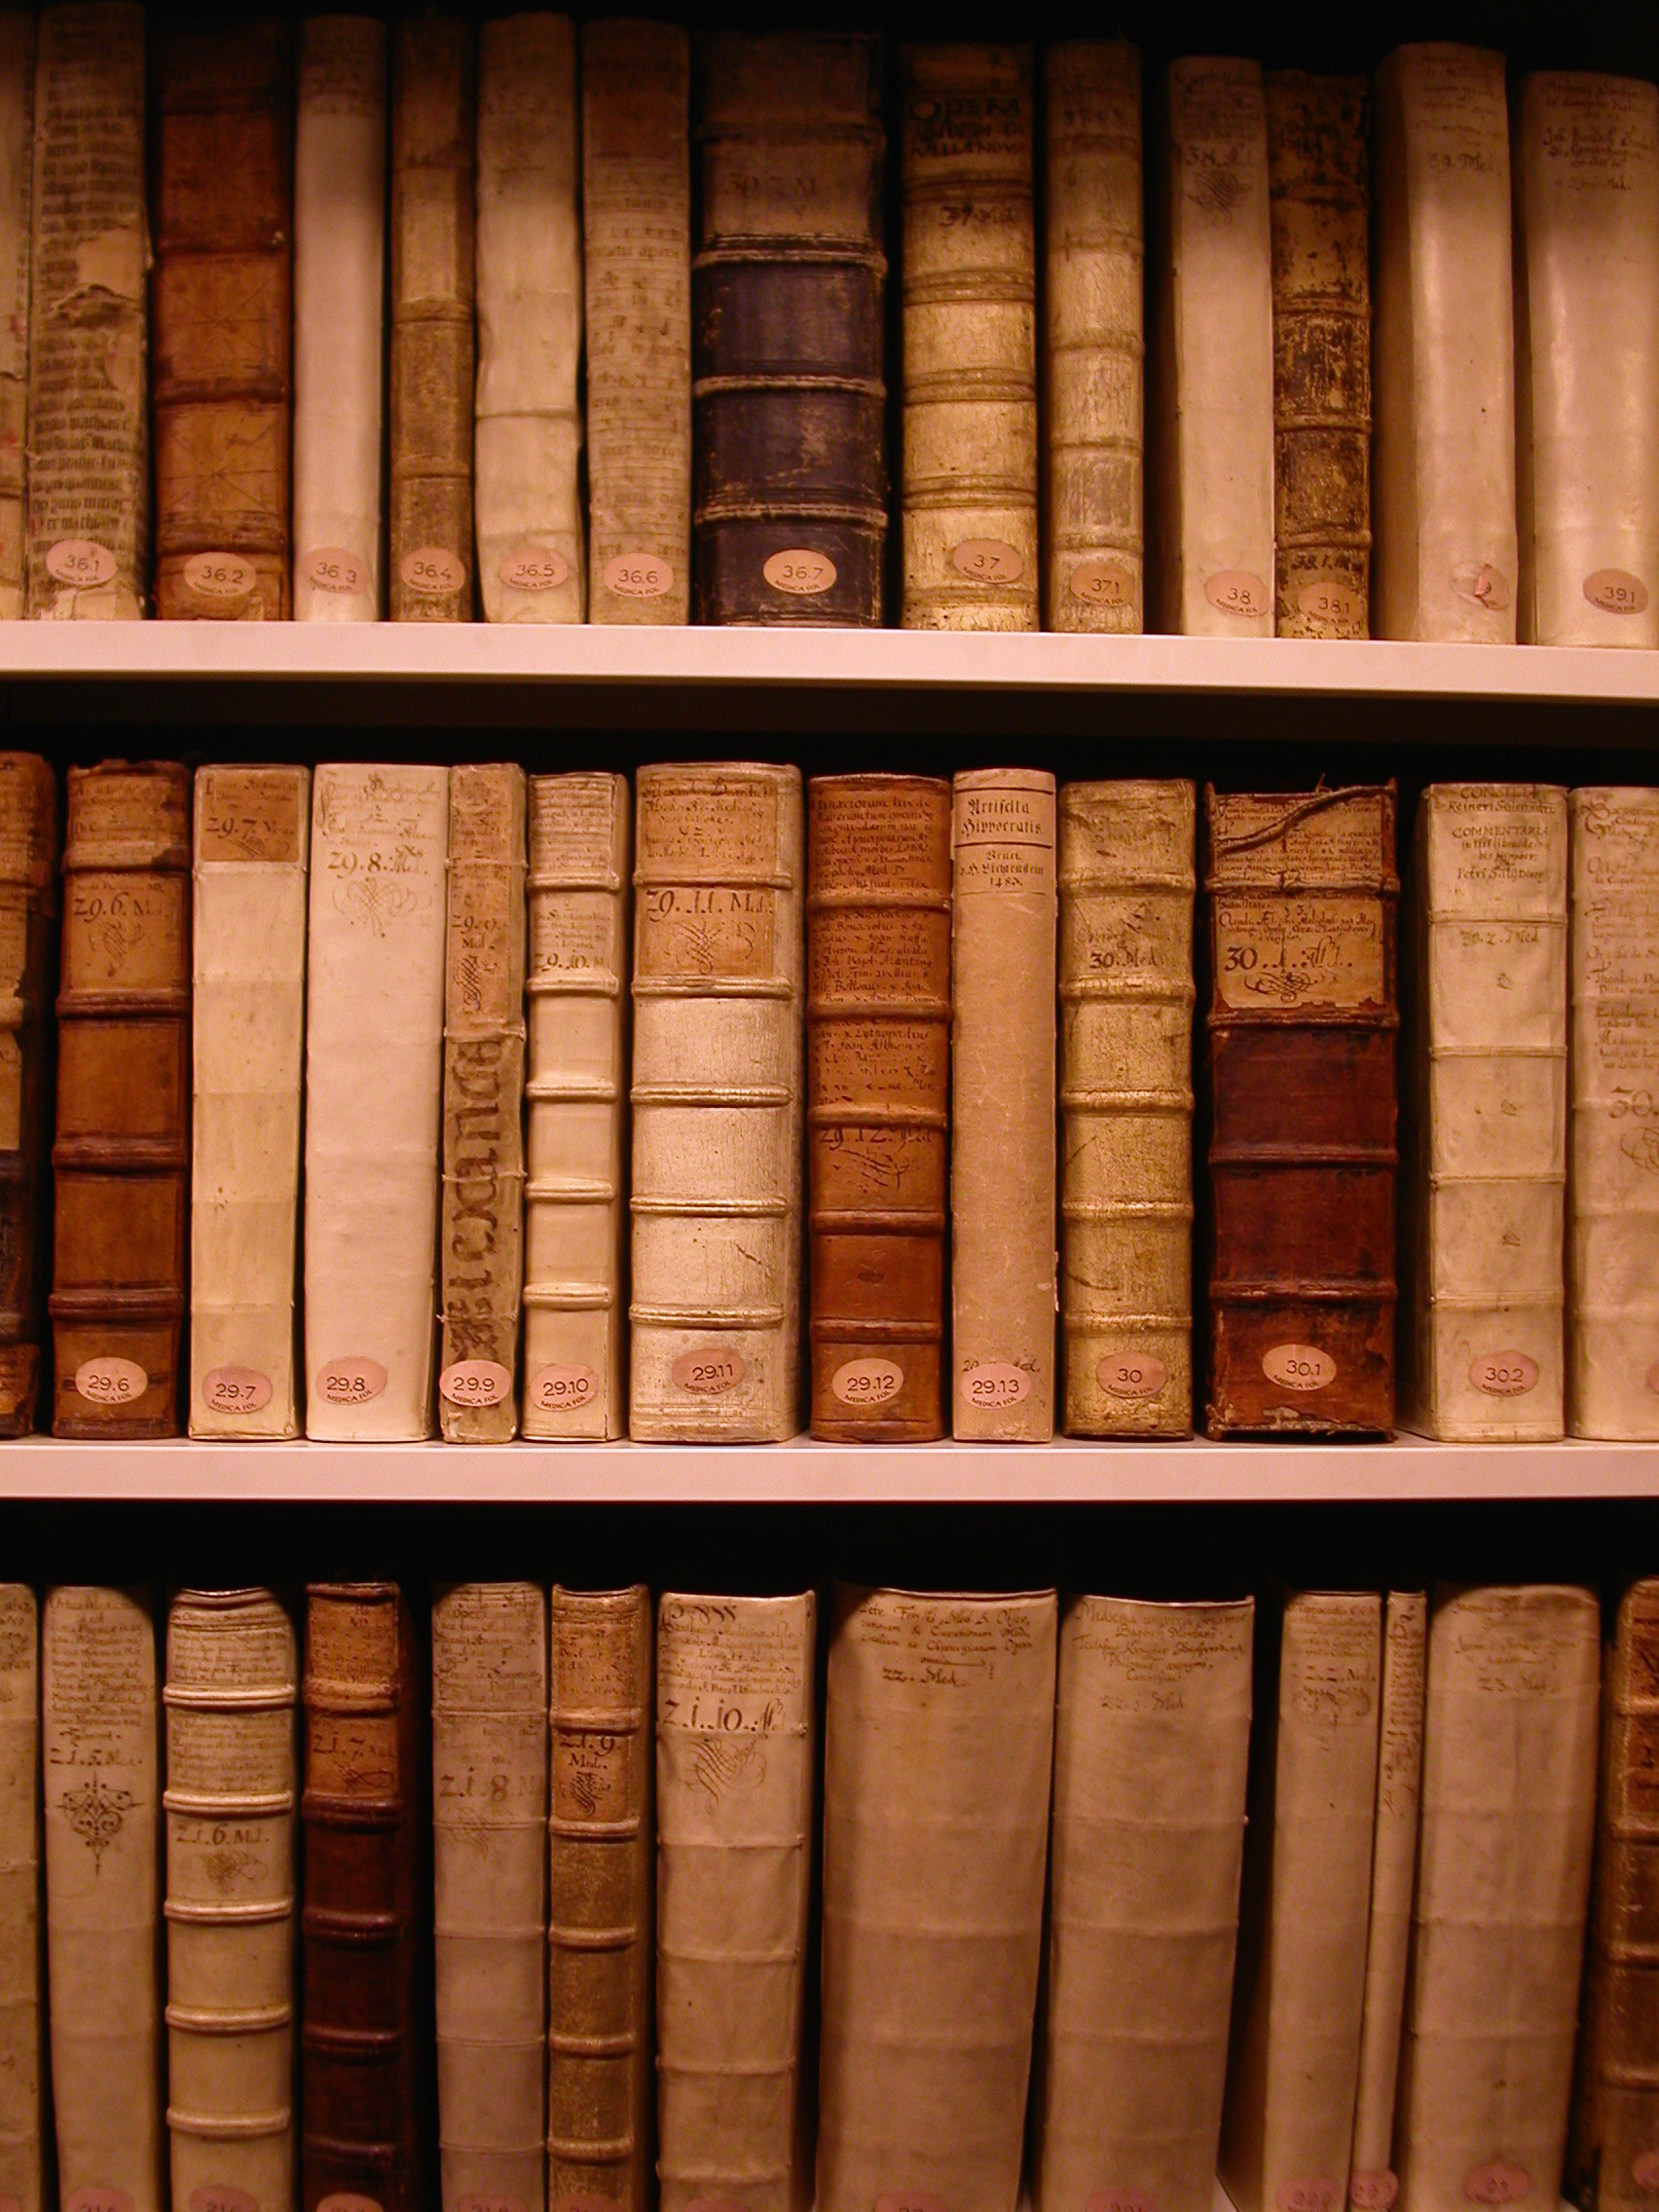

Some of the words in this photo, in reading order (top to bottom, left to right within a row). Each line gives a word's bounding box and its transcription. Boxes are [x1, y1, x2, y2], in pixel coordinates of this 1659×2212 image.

[974, 554, 1000, 570] 37
[202, 566, 243, 584] 36.2
[414, 562, 452, 581] 36.4
[515, 564, 555, 577] 36.5
[618, 569, 658, 584] 36.6
[782, 565, 824, 580] 36.7
[1090, 578, 1120, 595] 37.1
[1227, 587, 1251, 606] 38
[692, 1363, 734, 1382] 29.11
[1286, 1359, 1321, 1376] 30.1
[1485, 1367, 1524, 1382] 30.2
[88, 1374, 129, 1392] 29.6
[1117, 1368, 1142, 1383] 30
[326, 1376, 366, 1392] 29.8
[453, 1377, 496, 1392] 29.9
[542, 1378, 589, 1396] 29.10
[846, 1375, 895, 1392] 29.12
[972, 1379, 1020, 1394] 29.13
[215, 1382, 257, 1401] 29.7
[327, 1394, 357, 1403] MEDICA
[452, 1393, 483, 1405] MEDICA
[845, 1394, 875, 1404] MEDICA
[541, 1400, 572, 1410] MEDICA
[972, 1397, 1002, 1408] MEDICA
